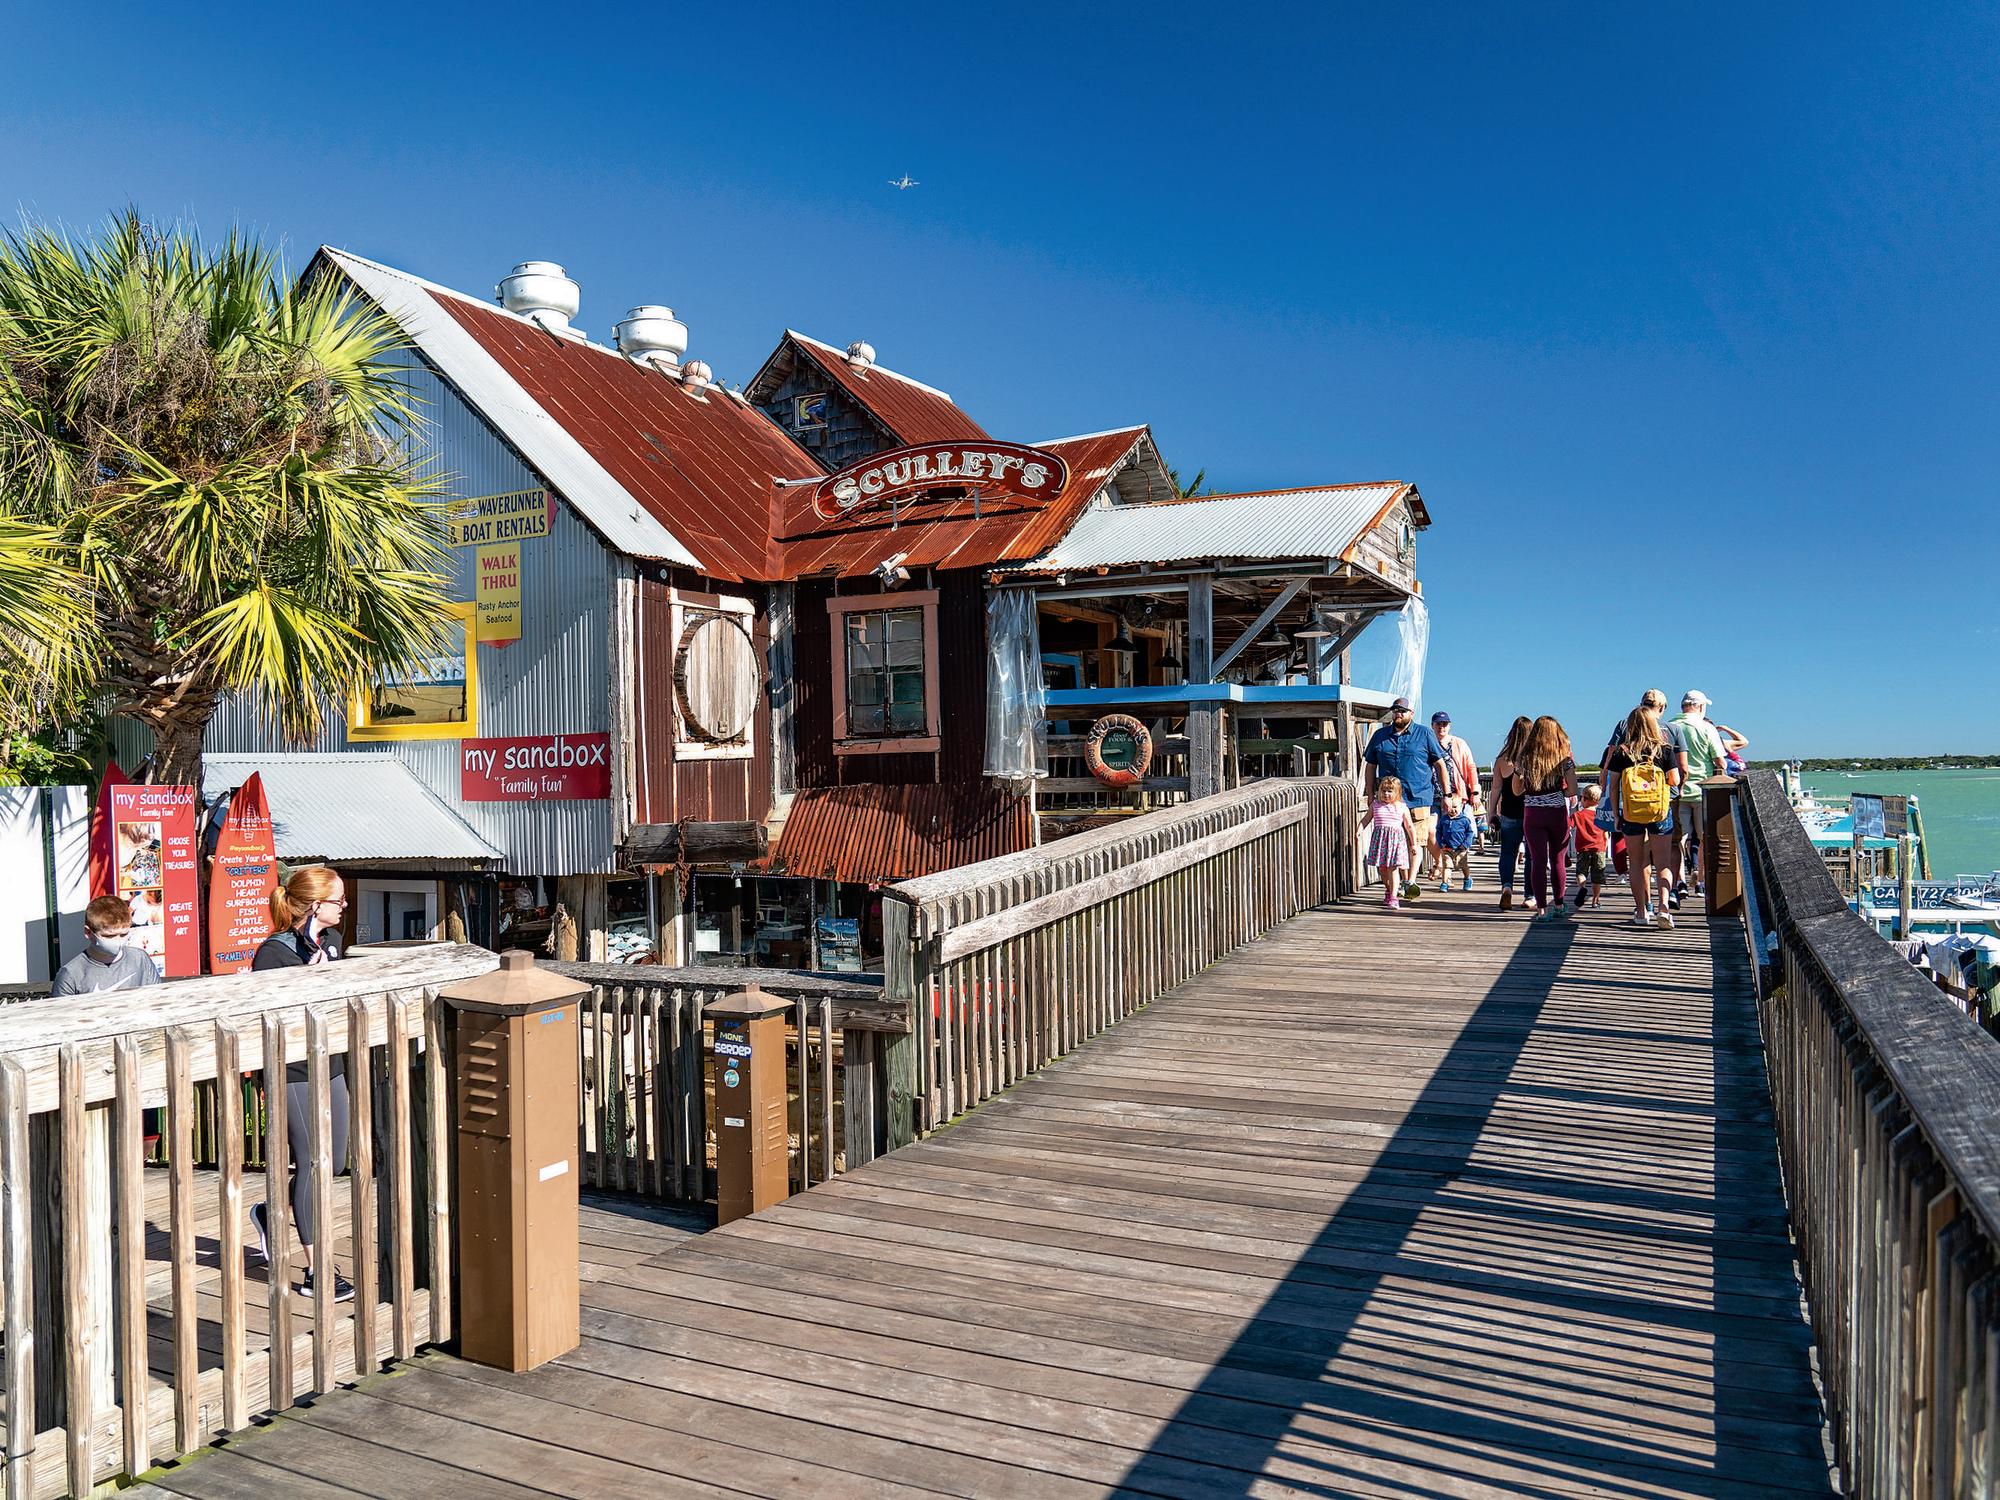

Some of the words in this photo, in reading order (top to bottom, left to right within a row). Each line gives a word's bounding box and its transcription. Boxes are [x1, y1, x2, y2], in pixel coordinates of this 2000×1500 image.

[832, 451, 1049, 508] SCULLEY'S
[478, 490, 545, 517] WAVERUNNER
[463, 522, 492, 542] BOAT
[496, 514, 546, 538] RENTALS
[482, 554, 517, 570] WALK
[482, 574, 517, 590] THRU
[477, 601, 496, 612] Rusty
[497, 600, 520, 610] Anchor
[485, 614, 513, 624] Seafood
[465, 749, 497, 780] my
[504, 736, 606, 770] sandbox
[494, 776, 538, 800] "Family
[541, 774, 568, 793] Fun"
[116, 793, 136, 809] my
[139, 790, 193, 805] sandbox
[168, 837, 190, 846] CHOOSE
[172, 849, 187, 857] YOUR
[219, 855, 243, 864] Create
[245, 854, 260, 863] Your
[262, 853, 275, 862] Own
[164, 860, 195, 870] TREASURES
[231, 879, 265, 889] DOLPHIN
[235, 888, 261, 897] HEART
[169, 902, 193, 912] CREATE
[225, 897, 270, 908] SURFBOARD
[239, 908, 259, 917] FISH
[172, 915, 190, 924] YOUR
[234, 916, 263, 926] TURTLE
[175, 927, 189, 936] ART
[228, 925, 269, 937] SEAHORSE
